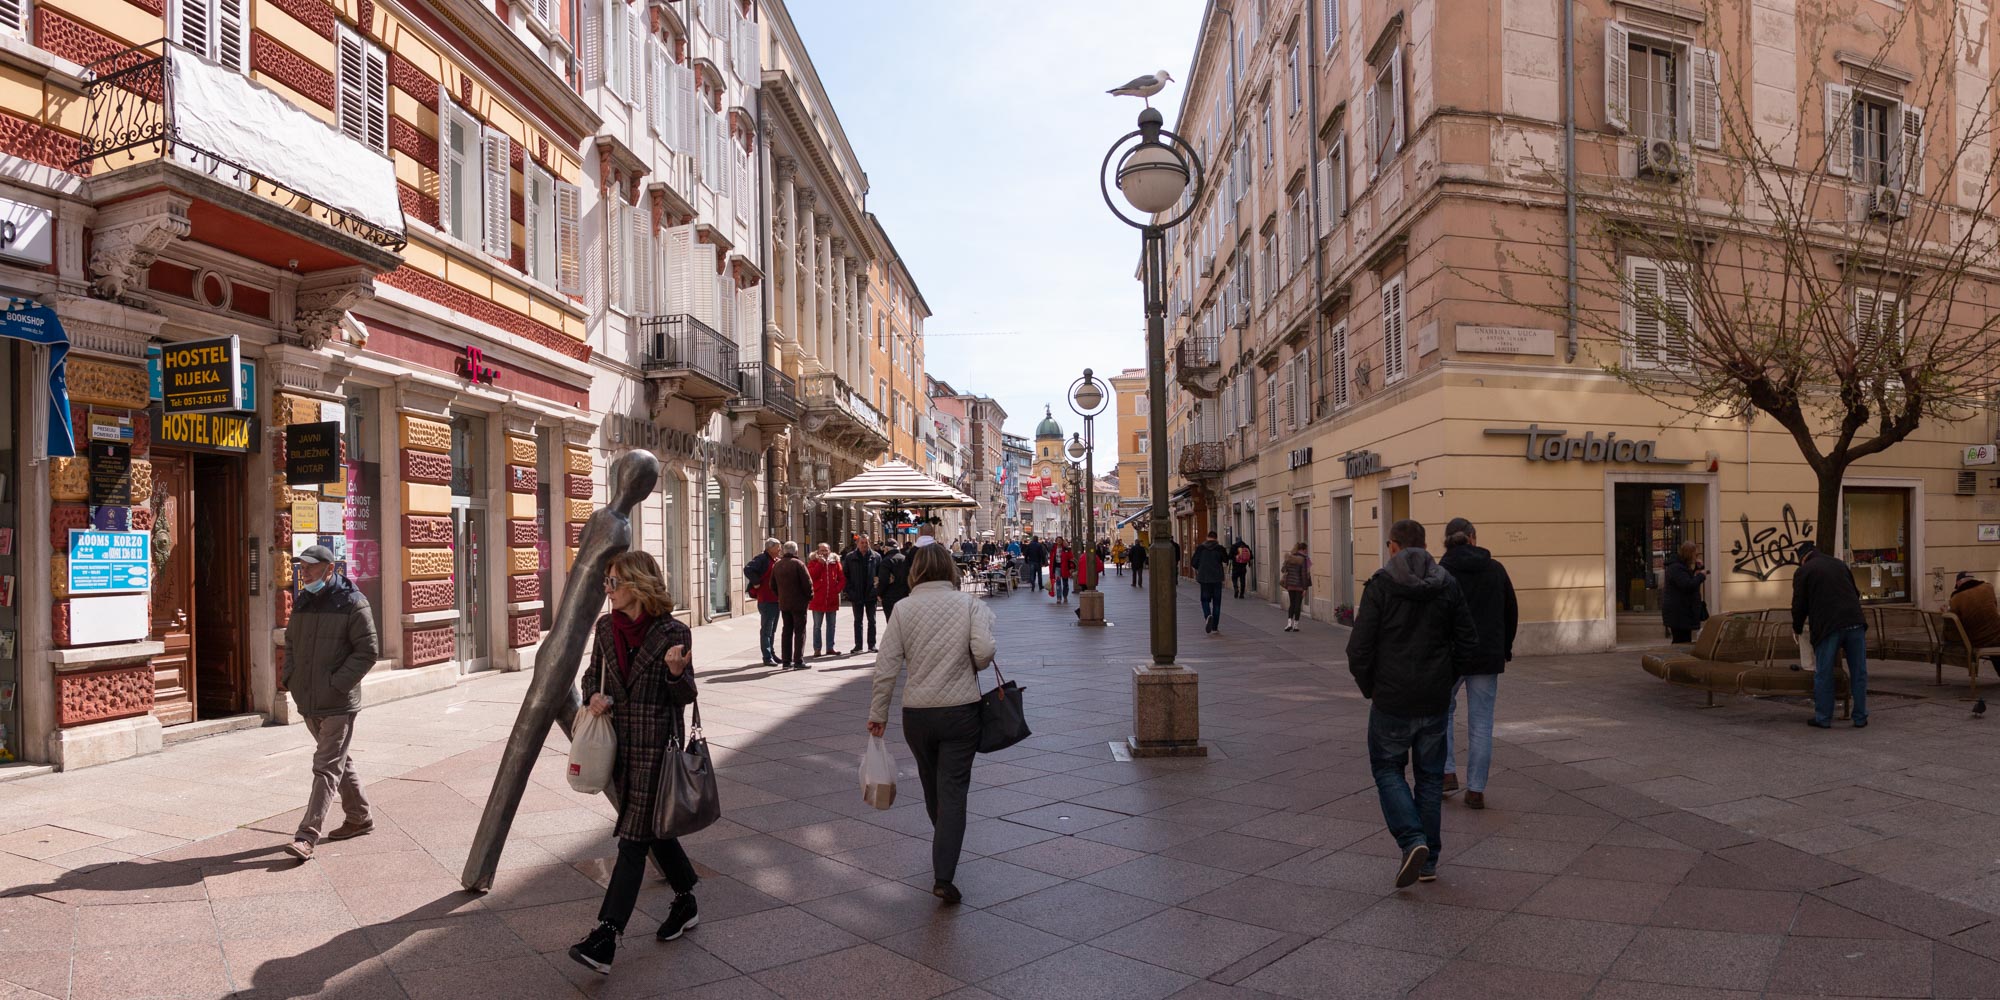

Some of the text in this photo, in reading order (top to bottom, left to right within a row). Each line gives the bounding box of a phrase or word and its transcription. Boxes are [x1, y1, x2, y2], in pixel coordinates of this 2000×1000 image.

[6, 312, 45, 326] BOOKSHOP
[165, 345, 229, 369] HOSTEL
[174, 369, 220, 387] RIJEKA
[170, 398, 182, 407] Tel:
[213, 394, 227, 404] 415
[161, 413, 249, 449] HOSTEL RIJEKA
[298, 433, 321, 444] JAVNI
[296, 464, 324, 474] NOTAR
[358, 506, 371, 519] JOŠ
[345, 520, 368, 531] BRZINE
[78, 534, 143, 547] ROOMS KORZO
